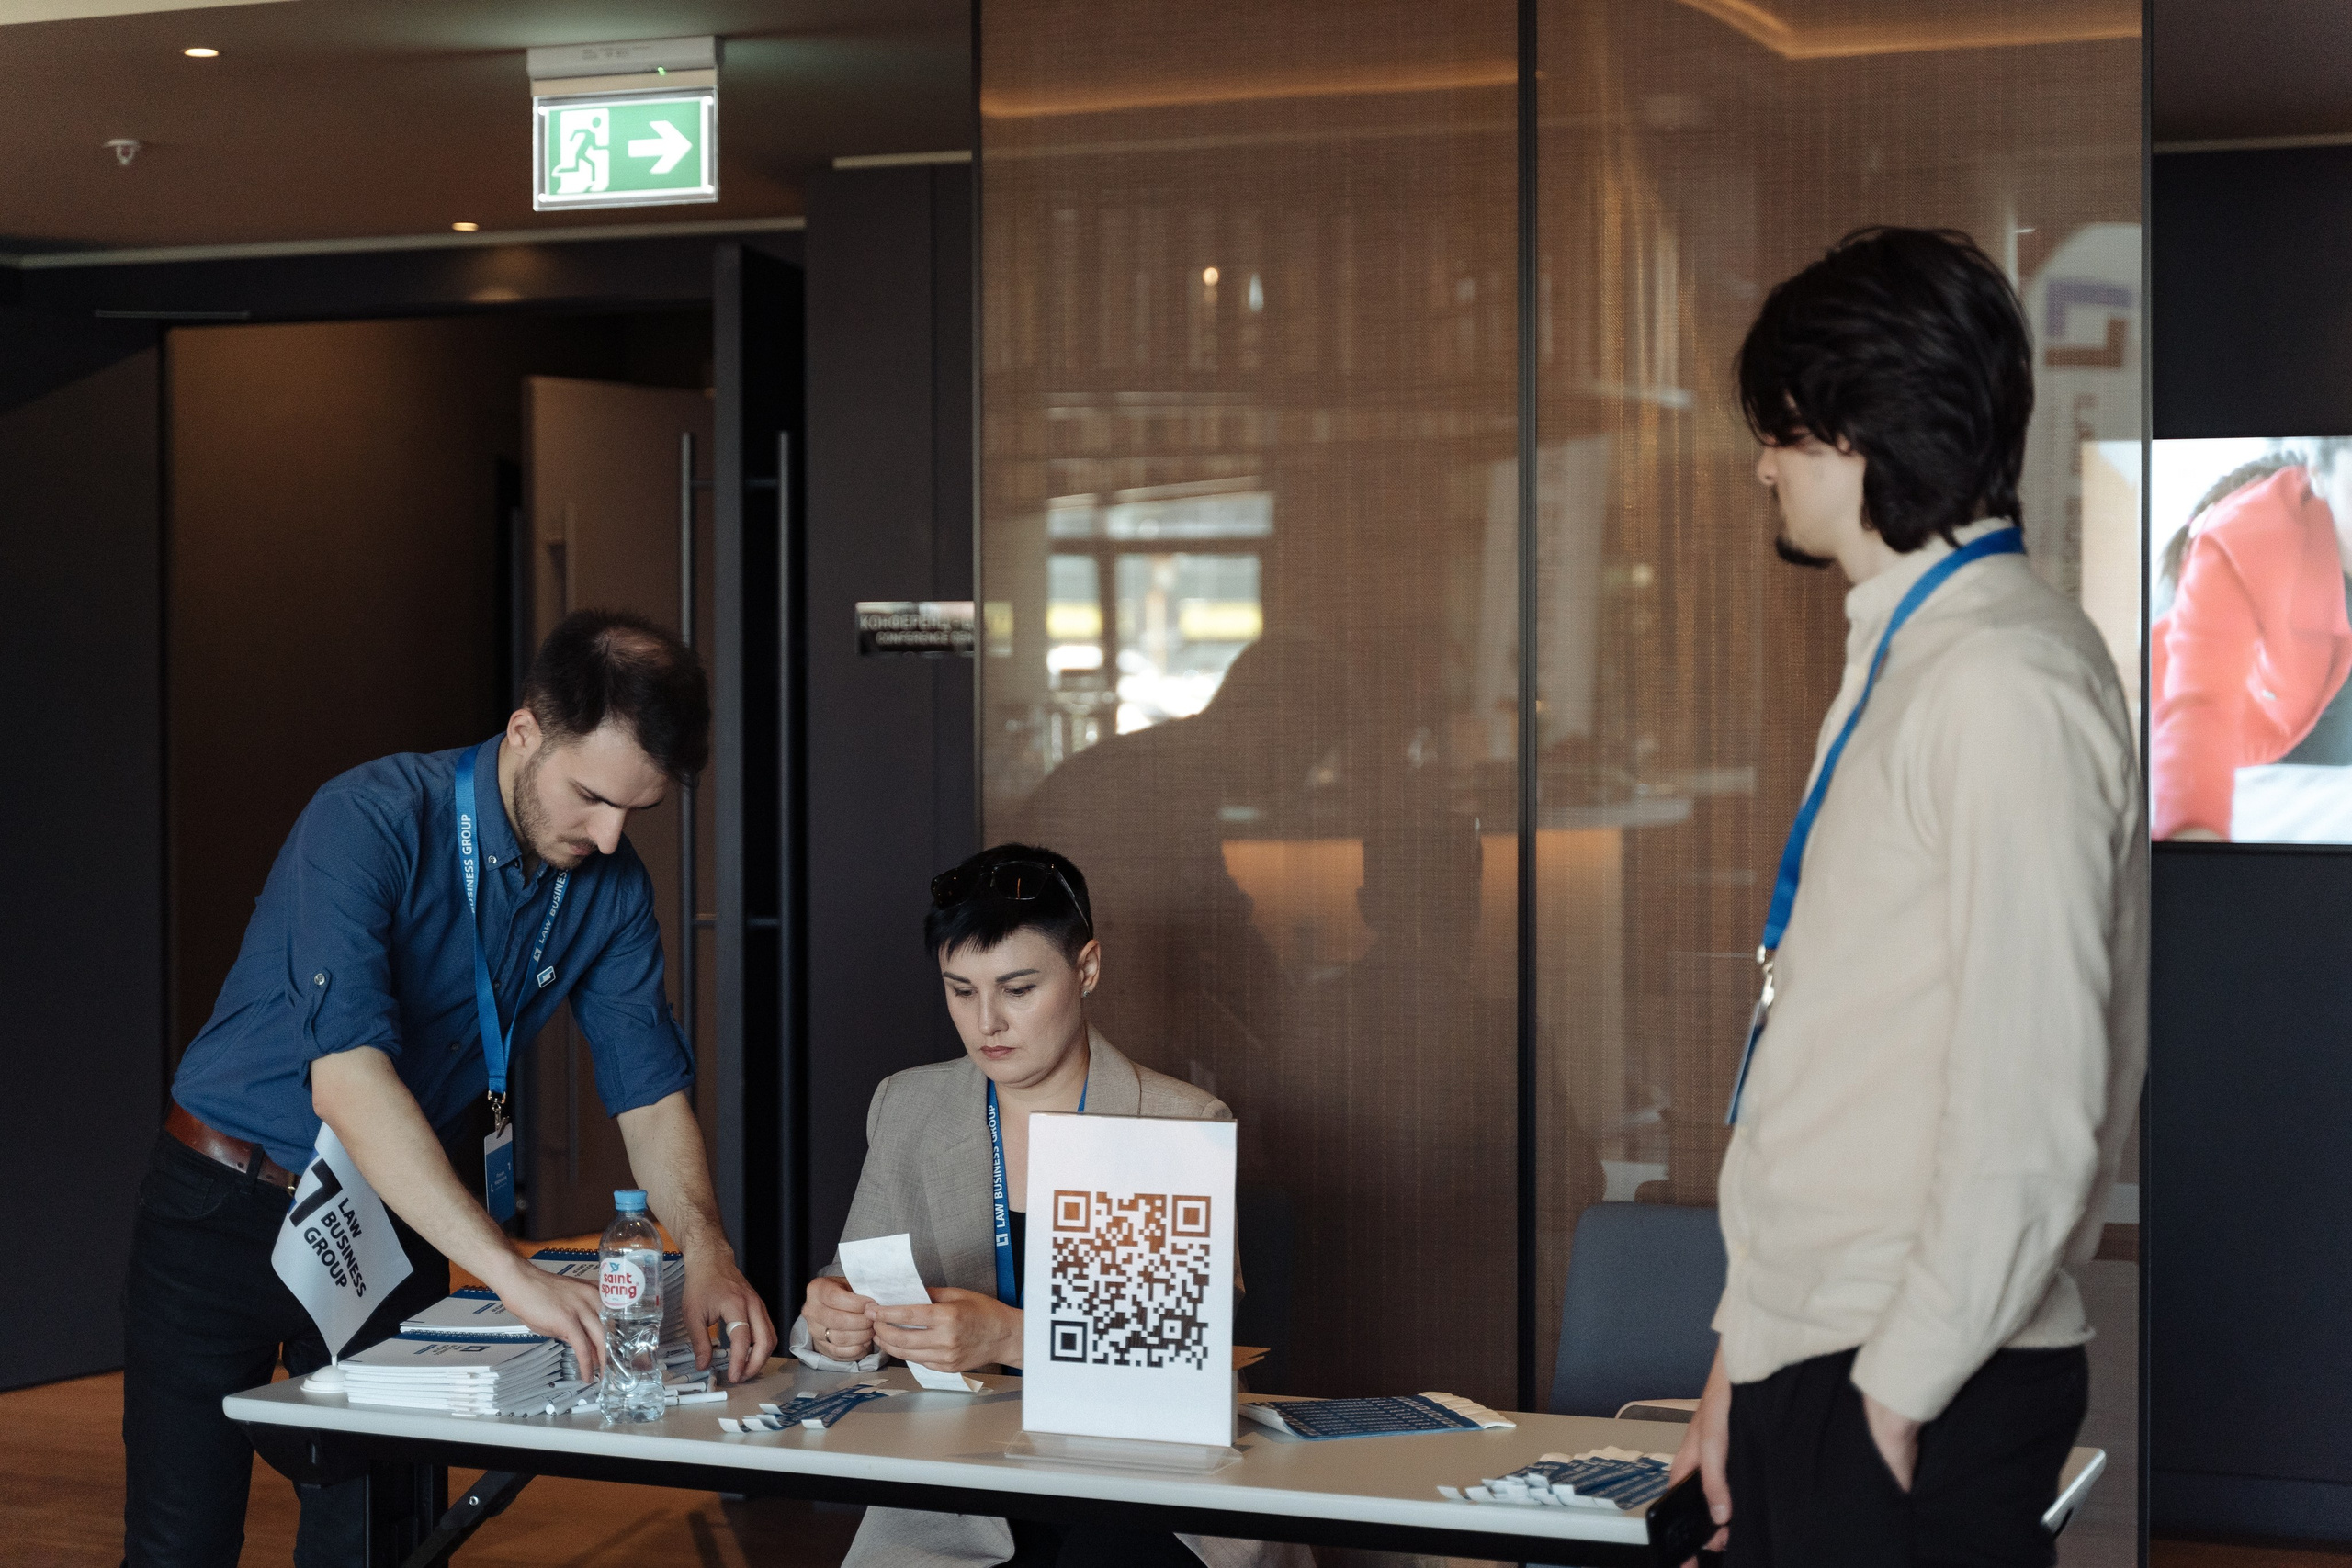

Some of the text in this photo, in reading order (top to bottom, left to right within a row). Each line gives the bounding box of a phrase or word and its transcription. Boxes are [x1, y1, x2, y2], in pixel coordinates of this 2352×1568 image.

[460, 814, 472, 855] GROUP
[538, 869, 569, 944] LAW BUSINES
[988, 1104, 1006, 1228] LAW BUSINESS GROUP
[337, 1198, 362, 1238] LAW
[303, 1227, 348, 1288] GROUP
[321, 1211, 367, 1297] BUSINESS
[604, 1272, 632, 1284] saint
[601, 1284, 637, 1299] spring
